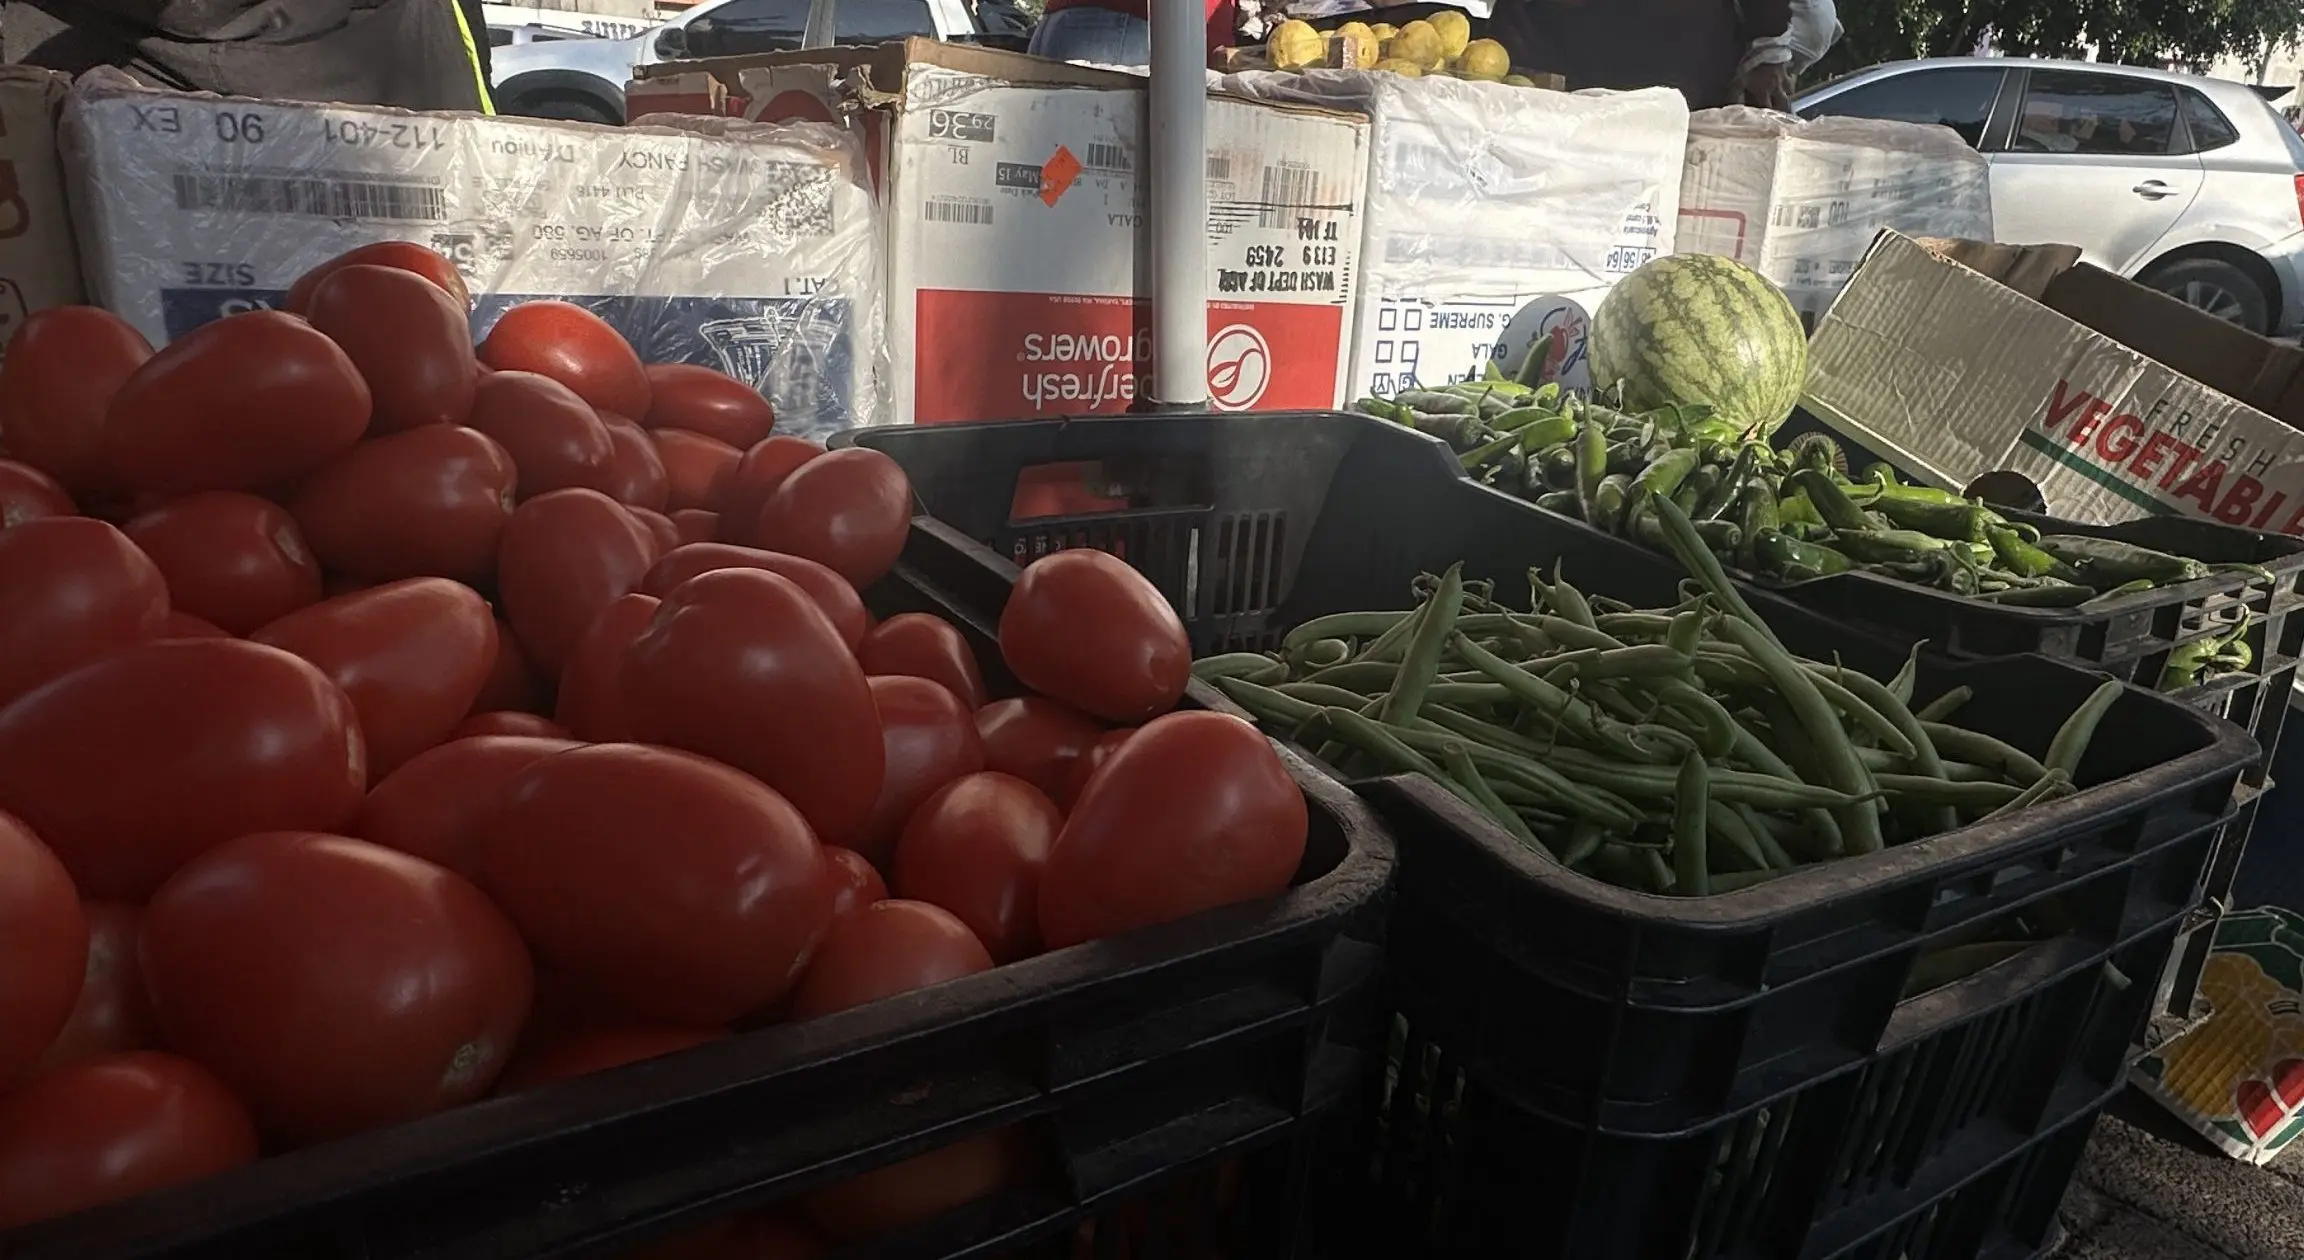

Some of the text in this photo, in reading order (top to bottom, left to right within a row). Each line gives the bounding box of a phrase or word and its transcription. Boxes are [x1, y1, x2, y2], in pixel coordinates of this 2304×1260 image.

[127, 104, 444, 151] 112-401 90 EX
[948, 147, 969, 164] BL
[1014, 167, 1040, 184] May
[1107, 214, 1143, 227] GALA
[1246, 246, 1285, 268] 2459
[183, 261, 255, 287] SIZE
[1267, 271, 1298, 291] DEPT
[1301, 271, 1335, 291] WASH
[1430, 312, 1495, 329] SUPREME
[1471, 342, 1508, 359] GALA
[2145, 398, 2277, 478] FRESH
